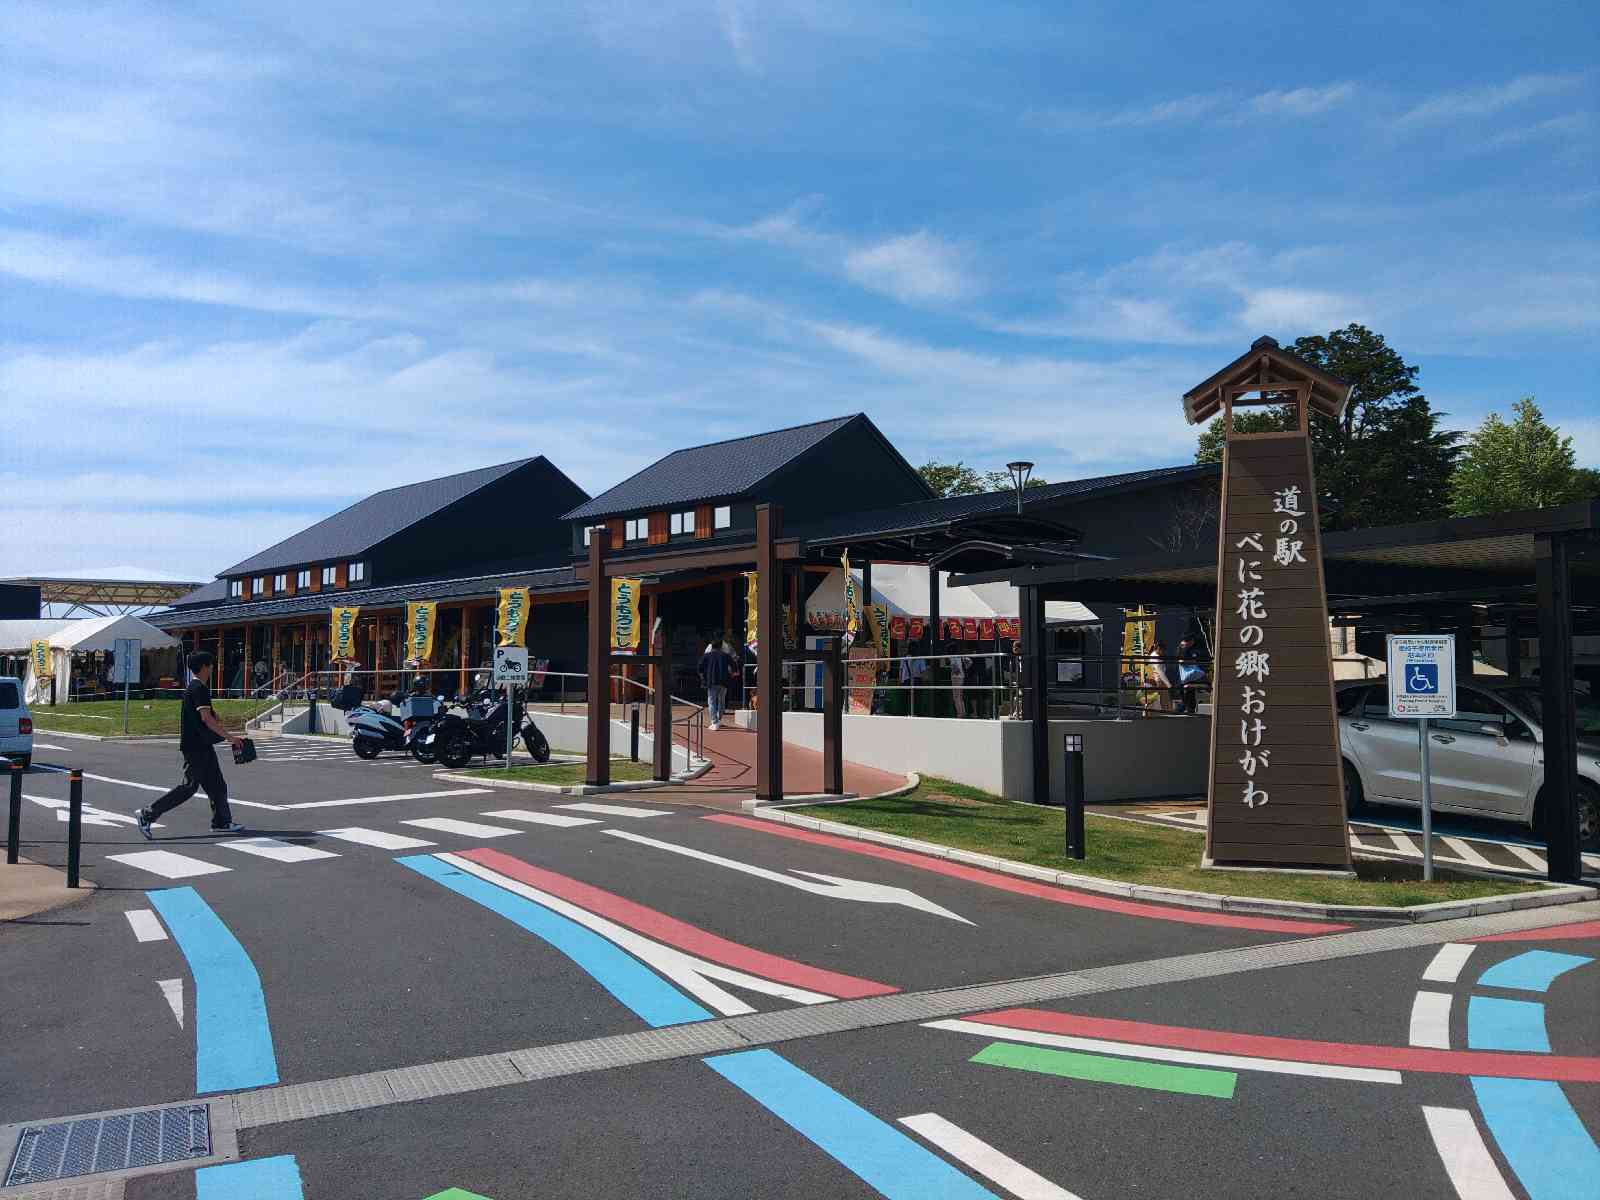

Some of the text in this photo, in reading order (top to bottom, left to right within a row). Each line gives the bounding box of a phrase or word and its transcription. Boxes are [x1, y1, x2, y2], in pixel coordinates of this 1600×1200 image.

[1273, 485, 1307, 566] 道の駅
[497, 650, 504, 658] P
[1235, 532, 1271, 809] べに花の郷おけがわ
